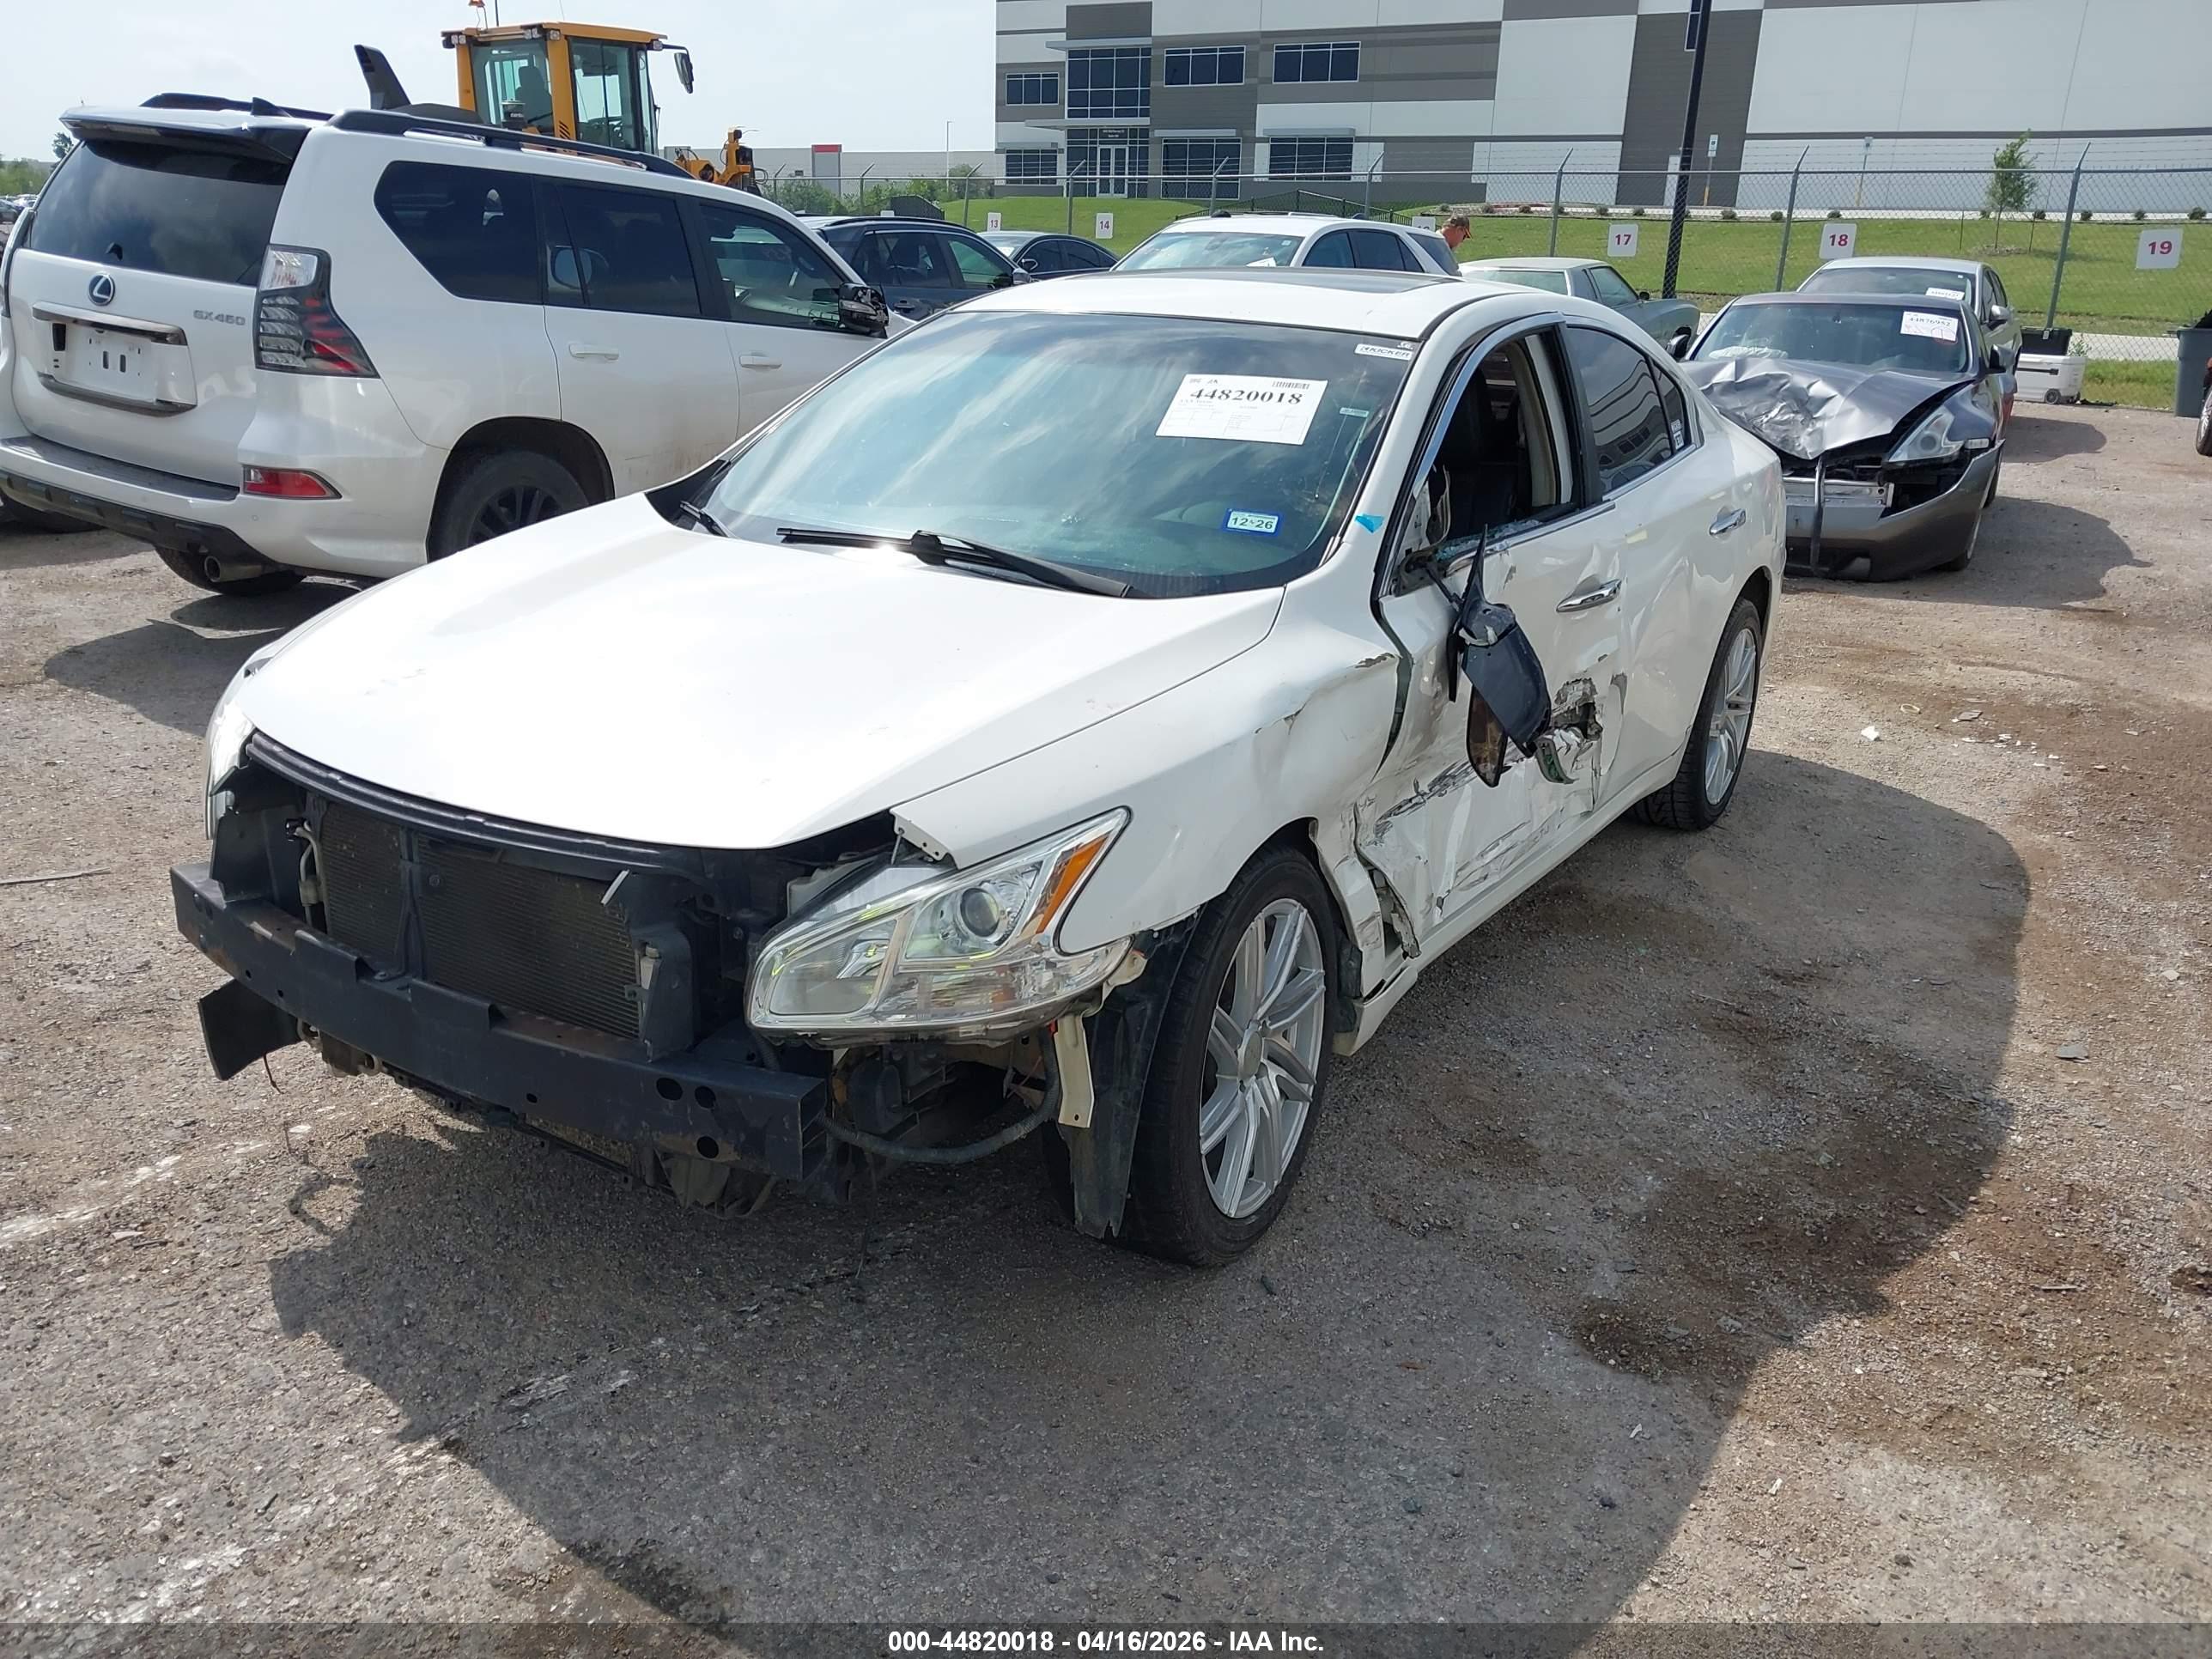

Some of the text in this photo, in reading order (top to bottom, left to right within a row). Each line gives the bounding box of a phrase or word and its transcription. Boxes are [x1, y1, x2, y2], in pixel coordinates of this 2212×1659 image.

[990, 219, 999, 228] 13
[1099, 220, 1109, 230] 14
[1615, 234, 1632, 246] 17
[1829, 234, 1849, 246] 18
[2148, 240, 2172, 255] 19
[193, 309, 246, 326] GX460
[1368, 346, 1411, 357] KICKER
[1189, 388, 1304, 405] 44820018
[1231, 517, 1249, 526] 12
[1255, 520, 1273, 530] 26
